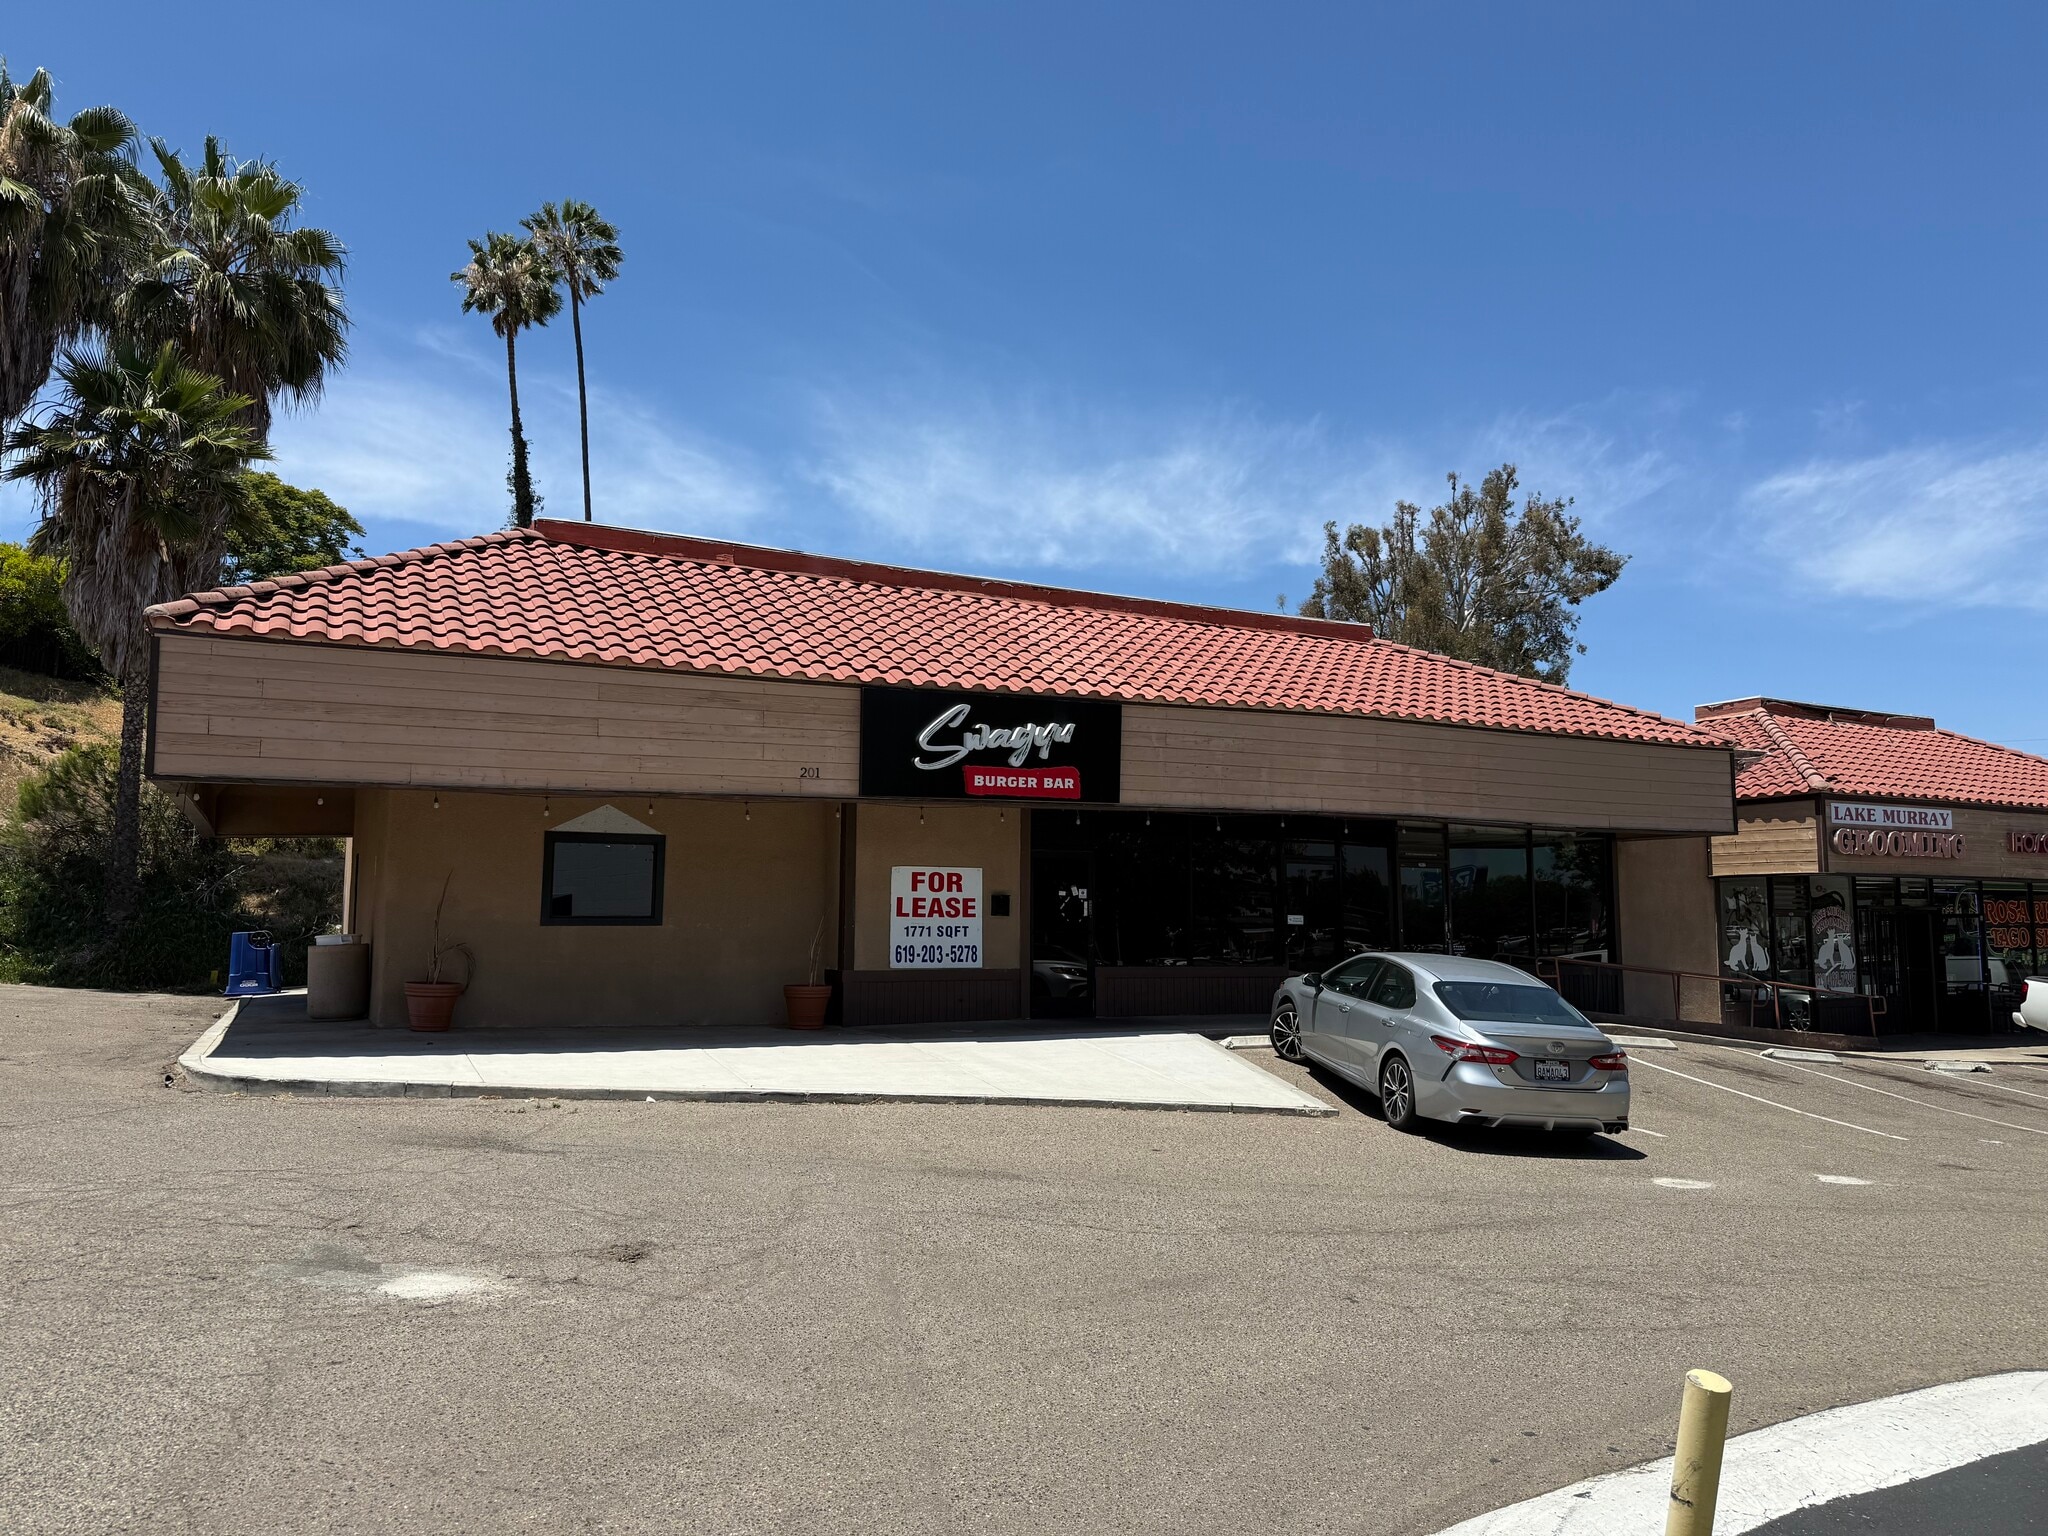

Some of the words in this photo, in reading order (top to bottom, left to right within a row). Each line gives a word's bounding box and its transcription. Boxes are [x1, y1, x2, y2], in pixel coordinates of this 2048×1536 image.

[912, 703, 1076, 770] Swagyu
[800, 767, 820, 779] 201
[974, 775, 1038, 789] BURGER
[1043, 777, 1075, 789] BAR
[1833, 806, 1877, 823] LAKE
[1882, 809, 1950, 827] MURRAY
[1833, 828, 1966, 859] GROOMING
[911, 871, 963, 893] FOR
[896, 896, 977, 918] LEASE
[904, 925, 931, 937] 1771
[936, 925, 969, 939] SQFT
[1990, 927, 2030, 949] TACO
[895, 944, 978, 963] 619-203-5278
